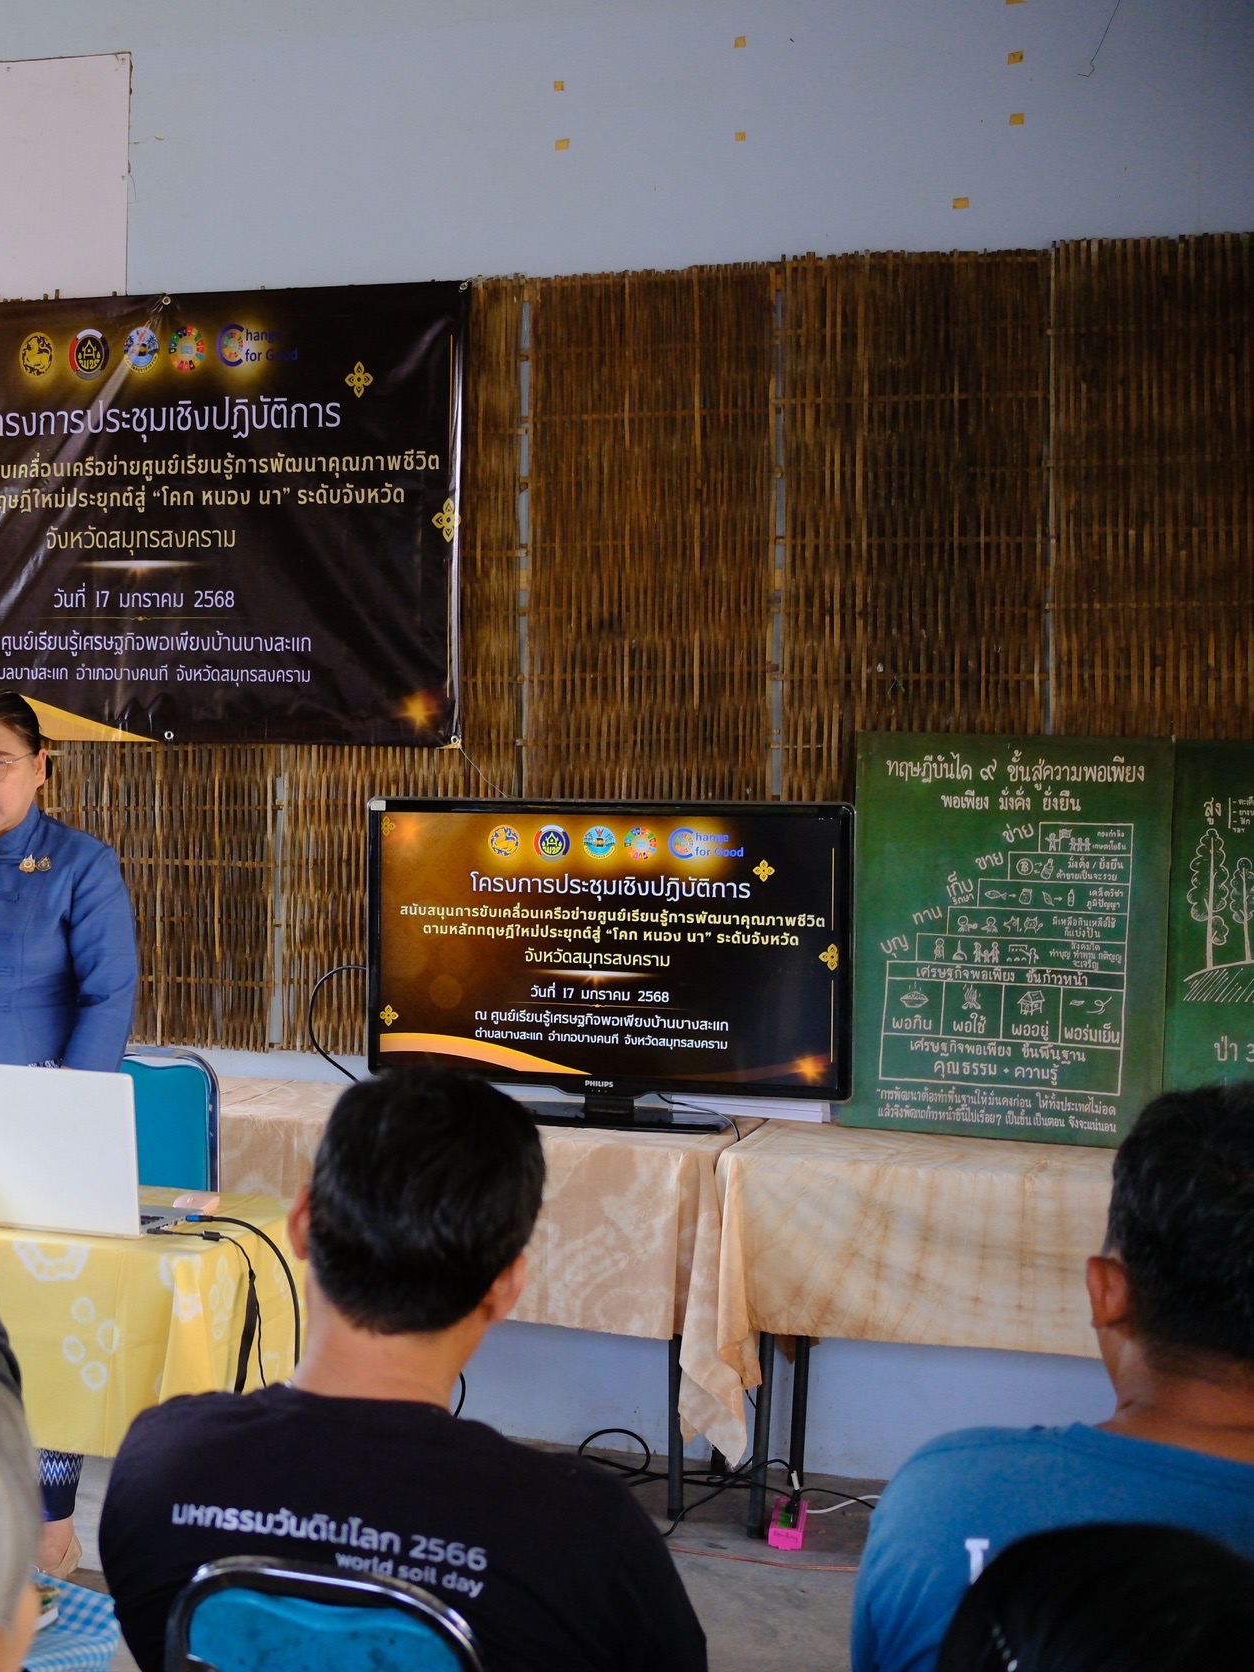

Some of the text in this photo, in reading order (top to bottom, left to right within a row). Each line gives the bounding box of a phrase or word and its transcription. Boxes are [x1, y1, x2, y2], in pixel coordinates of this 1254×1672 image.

[245, 348, 263, 362] for
[202, 489, 251, 506] หนอง
[298, 482, 405, 506] ระดับจังหวัด
[46, 525, 236, 556] จังหวัดสมุทรสงคราม
[54, 582, 235, 608] วันที่ 17 มกราคม 2568
[1, 629, 311, 657] ศูนย์เรียนรู้เศรษฐกิจพอเพียงบ้านบางสะแก
[76, 663, 168, 682] อำเภอบางคนที
[176, 663, 311, 687] จังหวัดสมุทรสงคราม
[886, 751, 973, 784] ทฤษฎีบันได
[1006, 749, 1145, 791] ขั้นสู่ความพอเพียง
[940, 786, 1082, 812] พอเพียง มั่งคั่ง ยั่งยืน
[1203, 797, 1222, 826] สูง
[1002, 822, 1035, 844] ข่าย
[695, 846, 744, 858] for Good
[975, 851, 1004, 871] ขาย
[1067, 856, 1124, 870] มั่งคั่ง ยั่งยืน
[470, 870, 751, 902] โครงการประชุมเชิงปฏิบัติการ
[946, 871, 974, 898] เก็บ
[400, 902, 826, 930] สนับสนุนการขับเคลื่อนเครือข่ายศูนย์เรียนรู้การพัฒนาคุณภาพชีวิต
[912, 905, 943, 926] ทาน
[1086, 898, 1121, 911] ภูมิปัญญา
[423, 923, 601, 943] ตามหลักทฤษฎีใหม่ประยุกต์สู่
[643, 930, 681, 943] หนอง
[716, 930, 799, 946] ระดับจังหวัด
[880, 934, 910, 959] บุญ
[524, 946, 671, 968] จังหวัดสมุทรสงคราม
[916, 965, 1088, 987] เศรษฐกิจพอเพียง ขั้นก้าวหน้า
[530, 982, 670, 1003] วันที่ 17 มกราคม 2568
[474, 1008, 729, 1032] ณ ศูนย์เรียนรู้เศรษฐกิจพอเพียงบ้านบางสะแก
[891, 1013, 1122, 1045] พอกิน พอใช้ พออยู่ พอร่มเย็น
[475, 1026, 728, 1051] ตำบลบางสะแก อำเภอบางคนที จังหวัดสมุทรสงคราม
[1214, 1035, 1238, 1062] ป่า
[909, 1039, 1087, 1066] เศรษฐกิจพอเพียง ขั้นพื้นฐาน
[584, 1080, 614, 1088] PHILIPS
[933, 1059, 1059, 1086] คุณธรรม ความรู้
[171, 1502, 488, 1573] มหกรรมวันดินโลก 2566
[335, 1550, 485, 1599] world soil day
